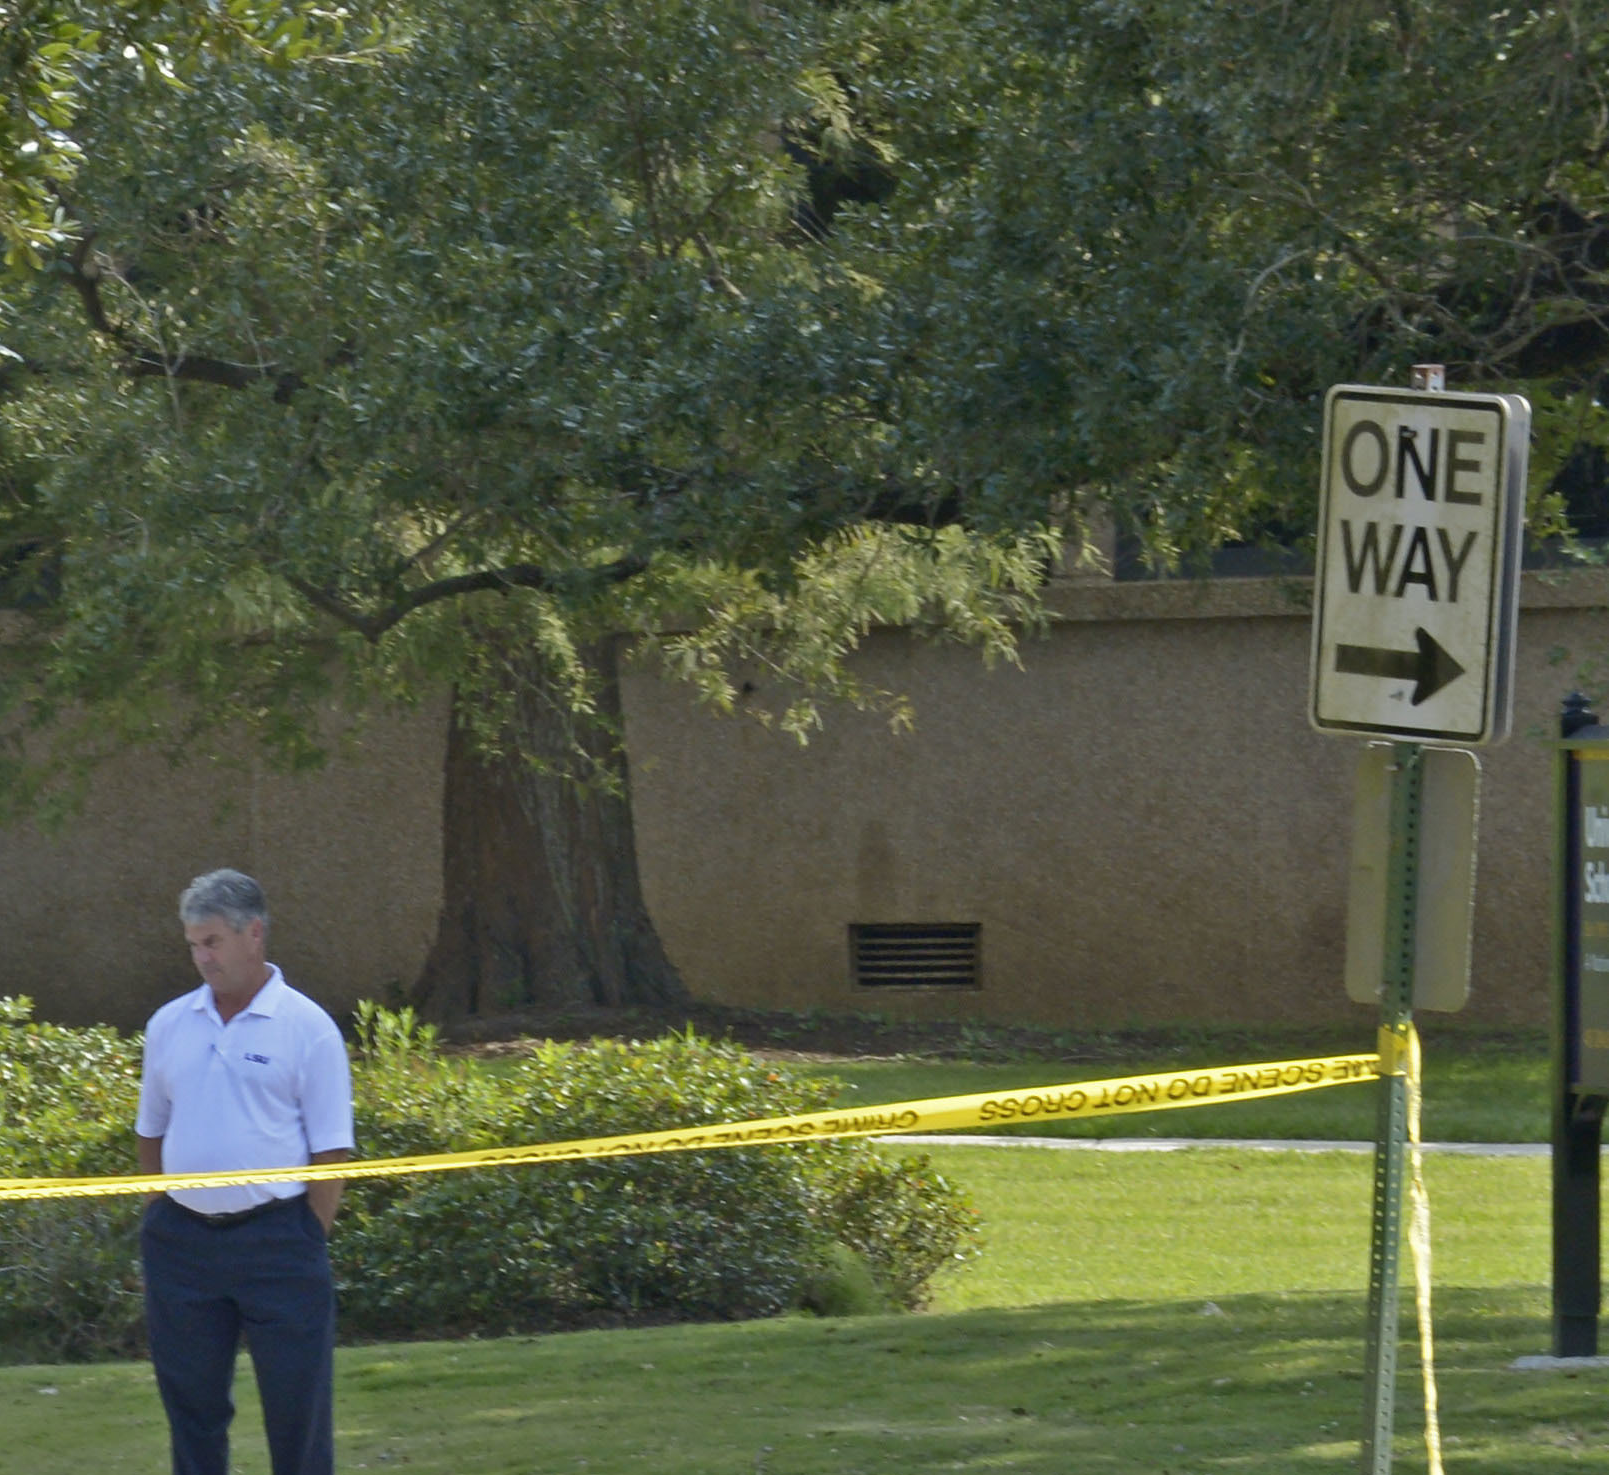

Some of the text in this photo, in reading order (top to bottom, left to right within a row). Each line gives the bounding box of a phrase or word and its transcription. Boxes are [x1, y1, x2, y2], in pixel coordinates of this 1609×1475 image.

[1341, 419, 1486, 506] ONE
[1340, 518, 1479, 603] WAY
[1166, 1075, 1212, 1100] DO
[1220, 1062, 1325, 1094] SCENE
[979, 1090, 1087, 1121] CROSS
[1092, 1081, 1159, 1109] NOT
